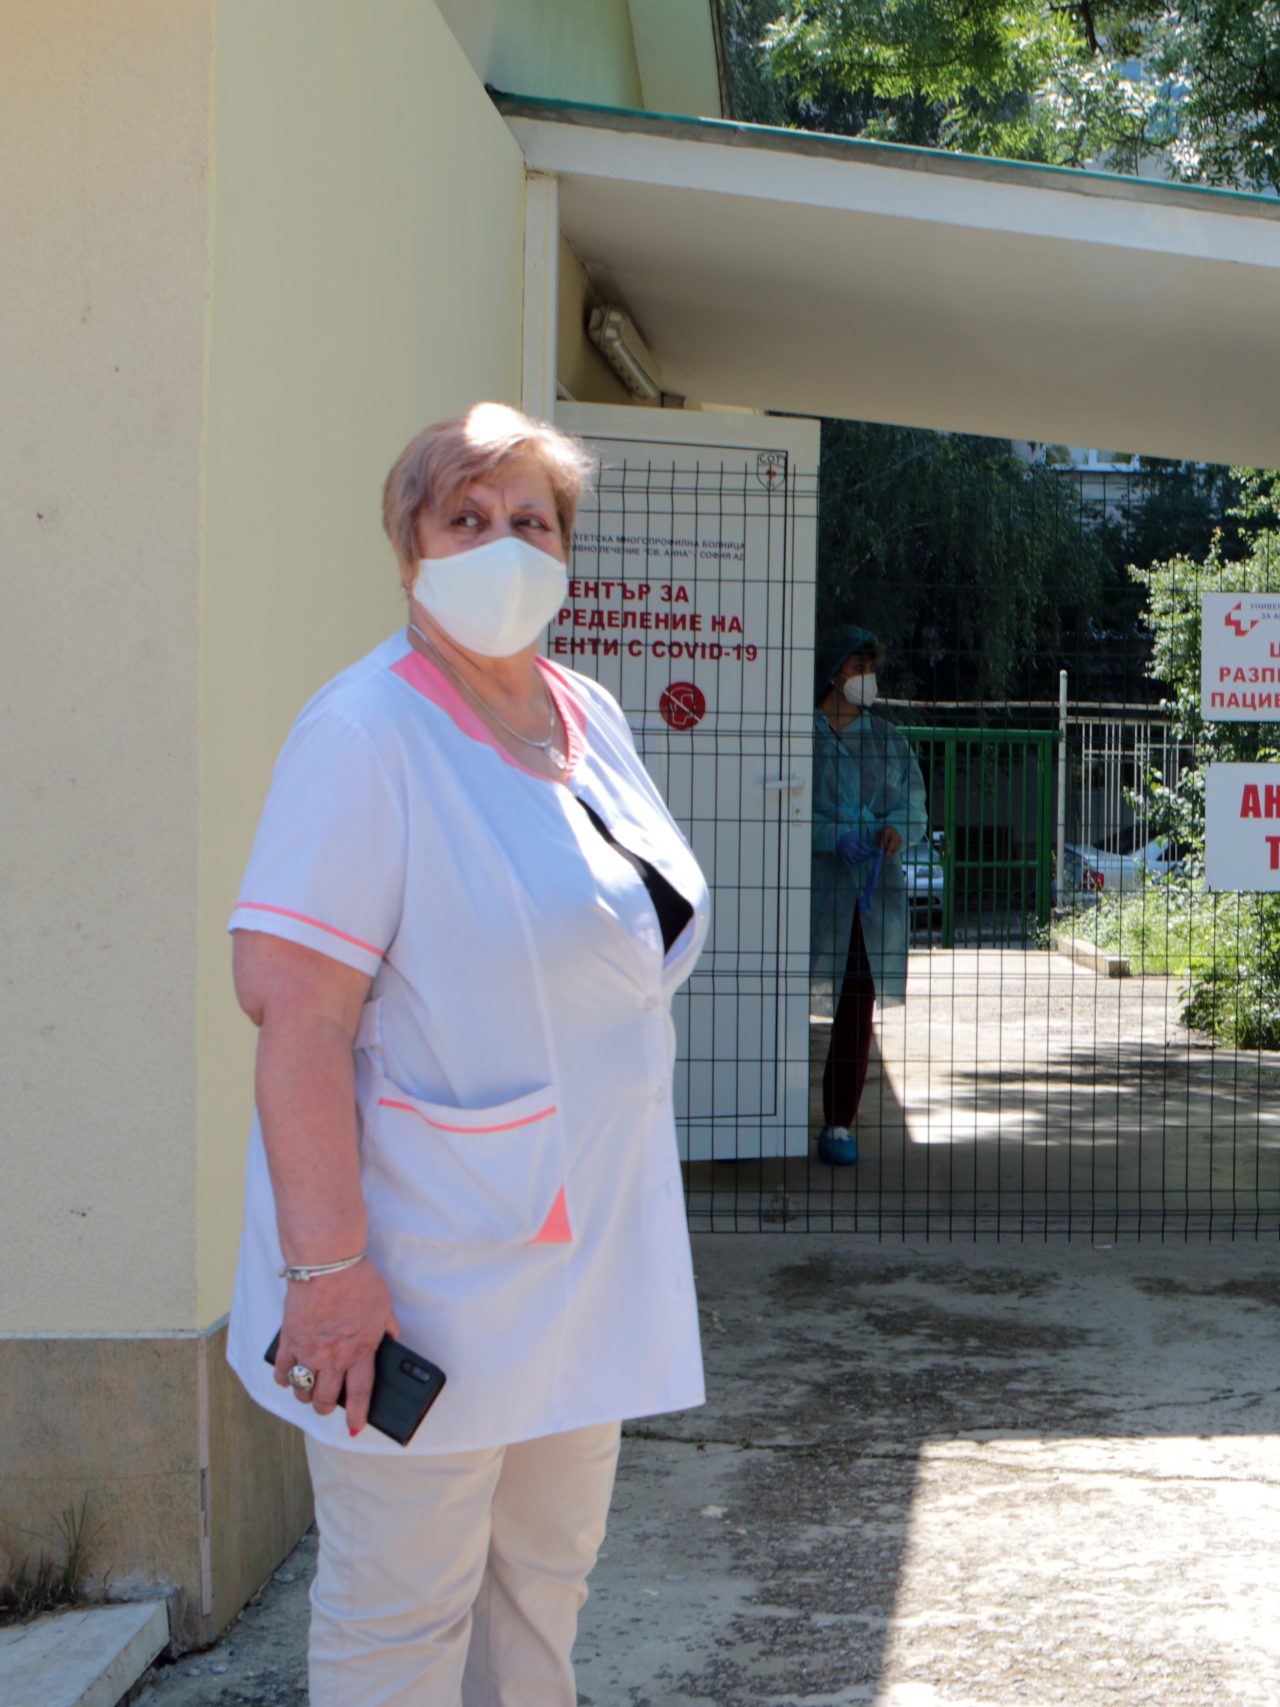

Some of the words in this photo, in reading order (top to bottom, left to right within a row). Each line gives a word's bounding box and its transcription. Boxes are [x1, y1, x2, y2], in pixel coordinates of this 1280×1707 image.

[568, 580, 651, 601] ЕНТЪР
[660, 584, 689, 603] ЗА
[711, 615, 743, 634] НА
[628, 639, 642, 657] С
[652, 640, 758, 662] COVID-19
